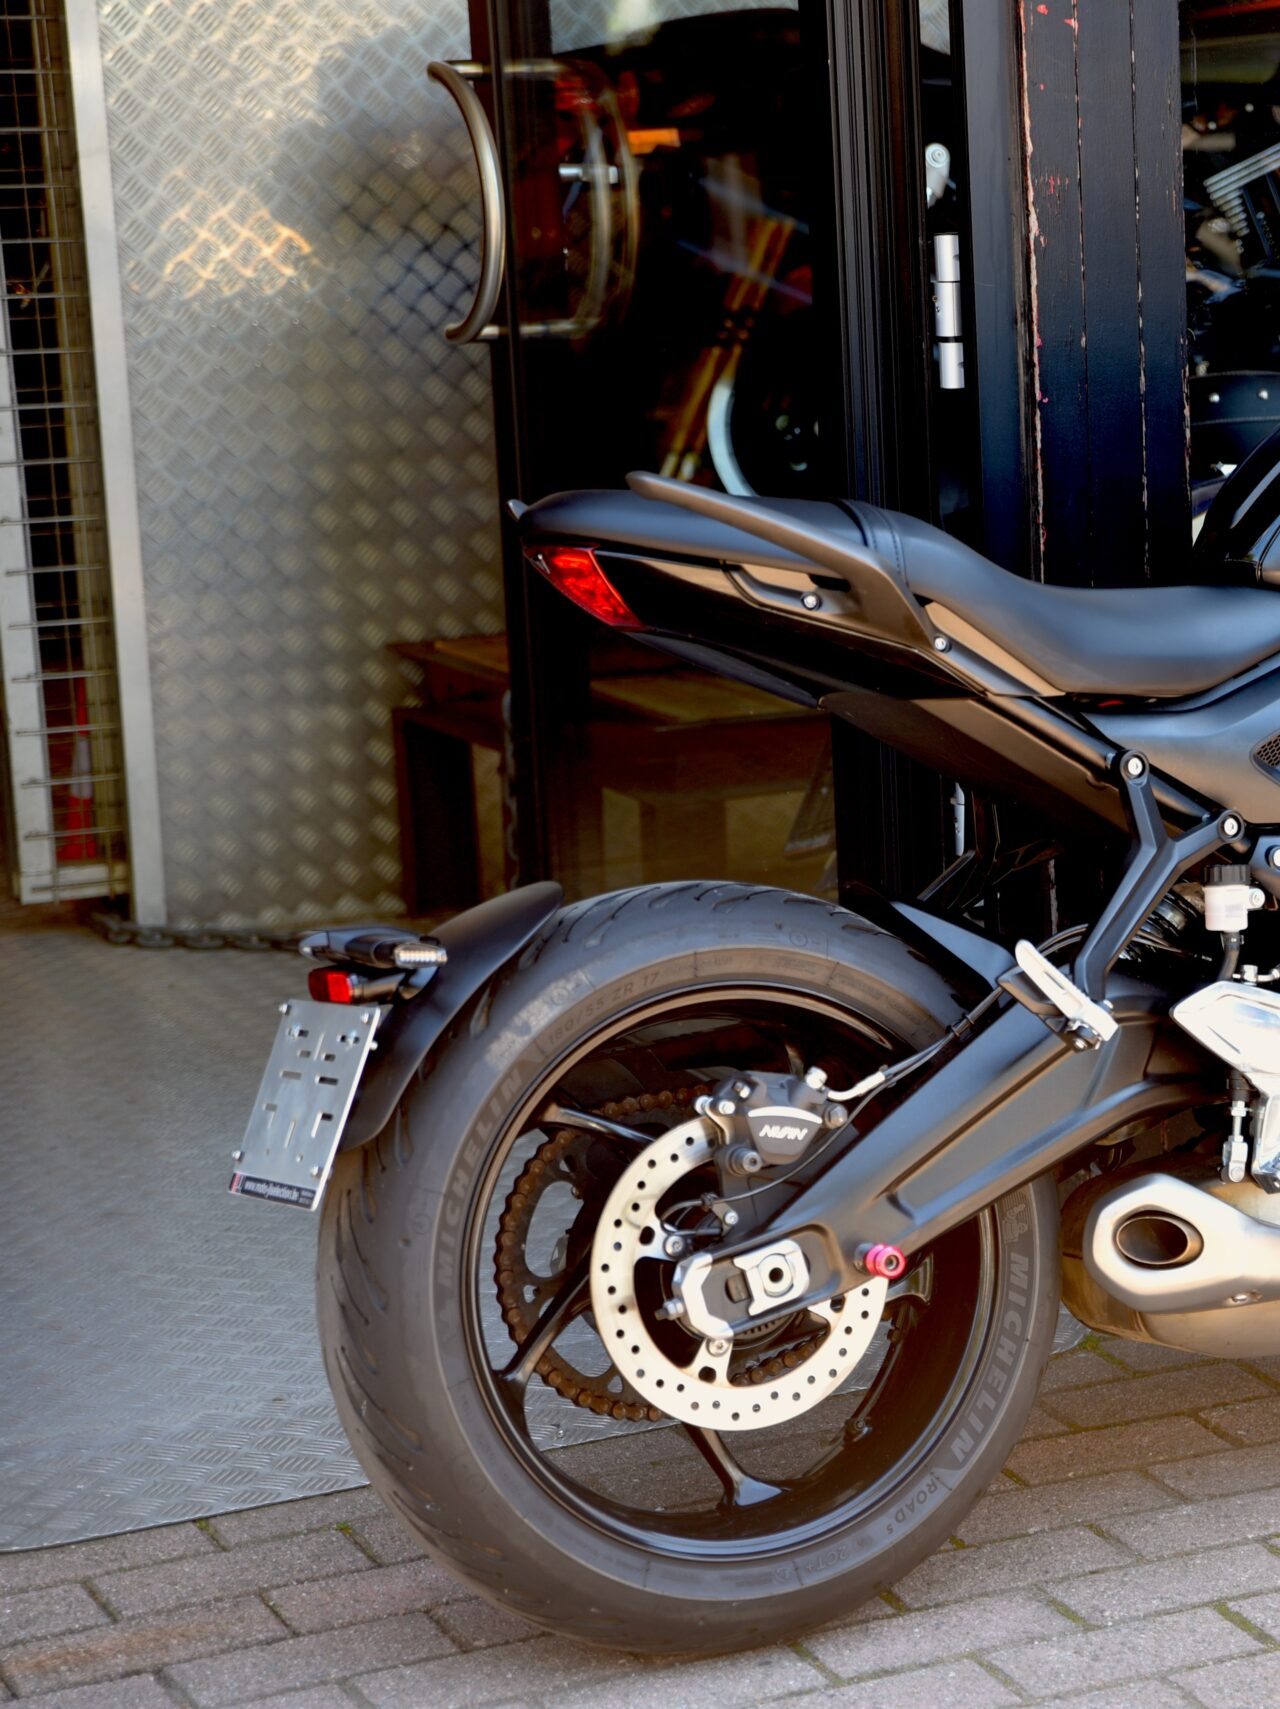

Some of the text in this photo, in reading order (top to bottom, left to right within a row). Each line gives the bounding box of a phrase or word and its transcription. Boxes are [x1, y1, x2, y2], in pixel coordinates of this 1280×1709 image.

[437, 1067, 523, 1287] MICHELIN
[951, 1252, 1029, 1463] MICHELIN
[894, 1481, 938, 1523] ROAD
